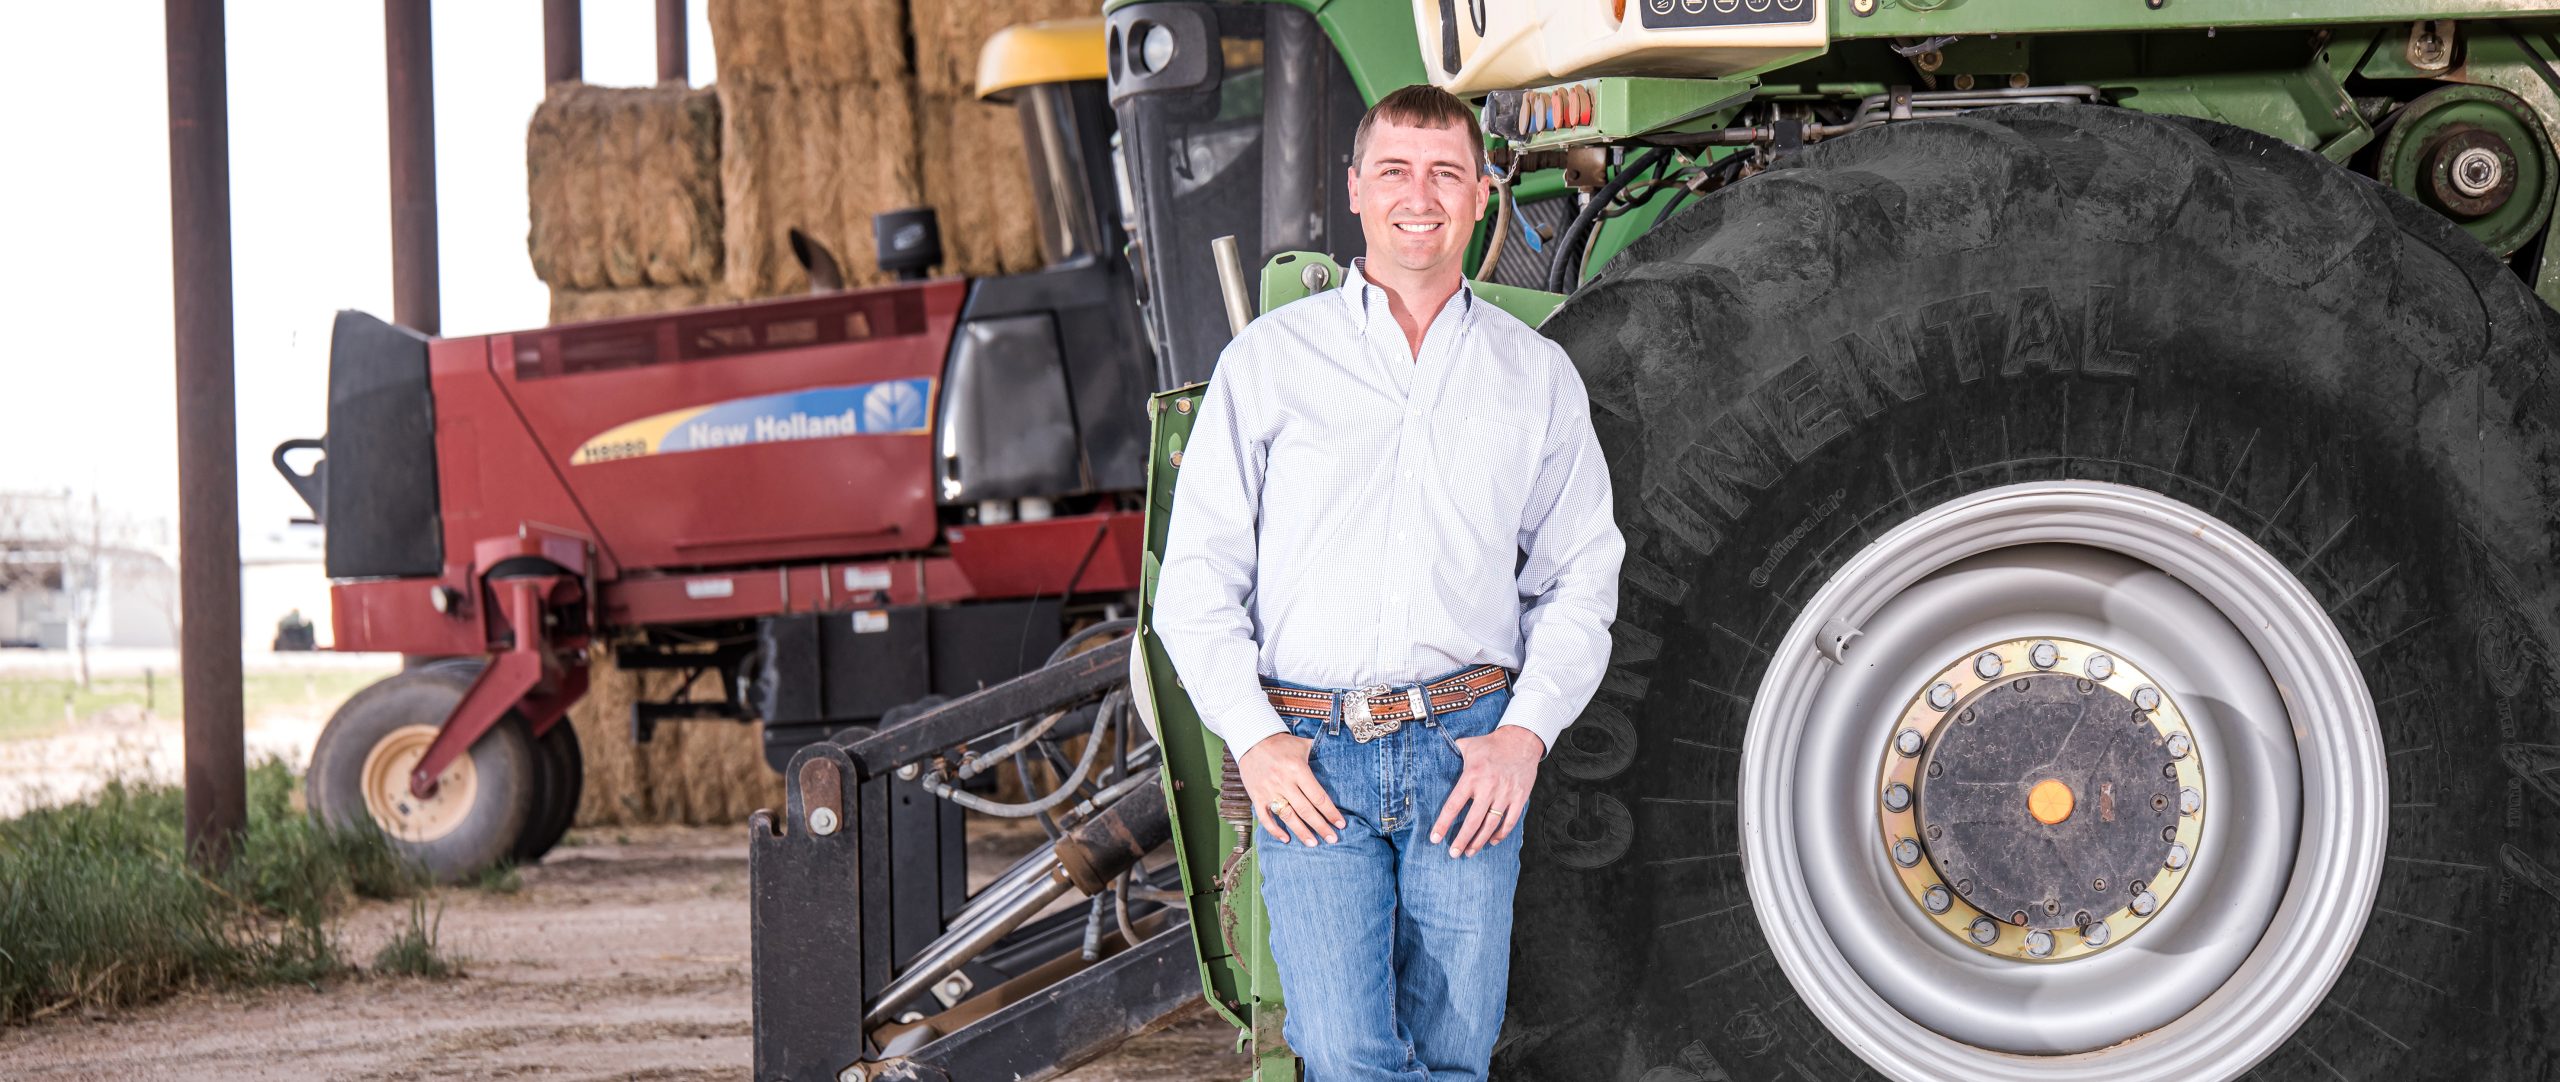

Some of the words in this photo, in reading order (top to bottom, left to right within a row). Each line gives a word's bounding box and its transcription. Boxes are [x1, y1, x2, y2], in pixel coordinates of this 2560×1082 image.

[688, 422, 748, 448] New
[754, 408, 856, 442] Holland
[1543, 284, 2140, 869] CONTINENTAL
